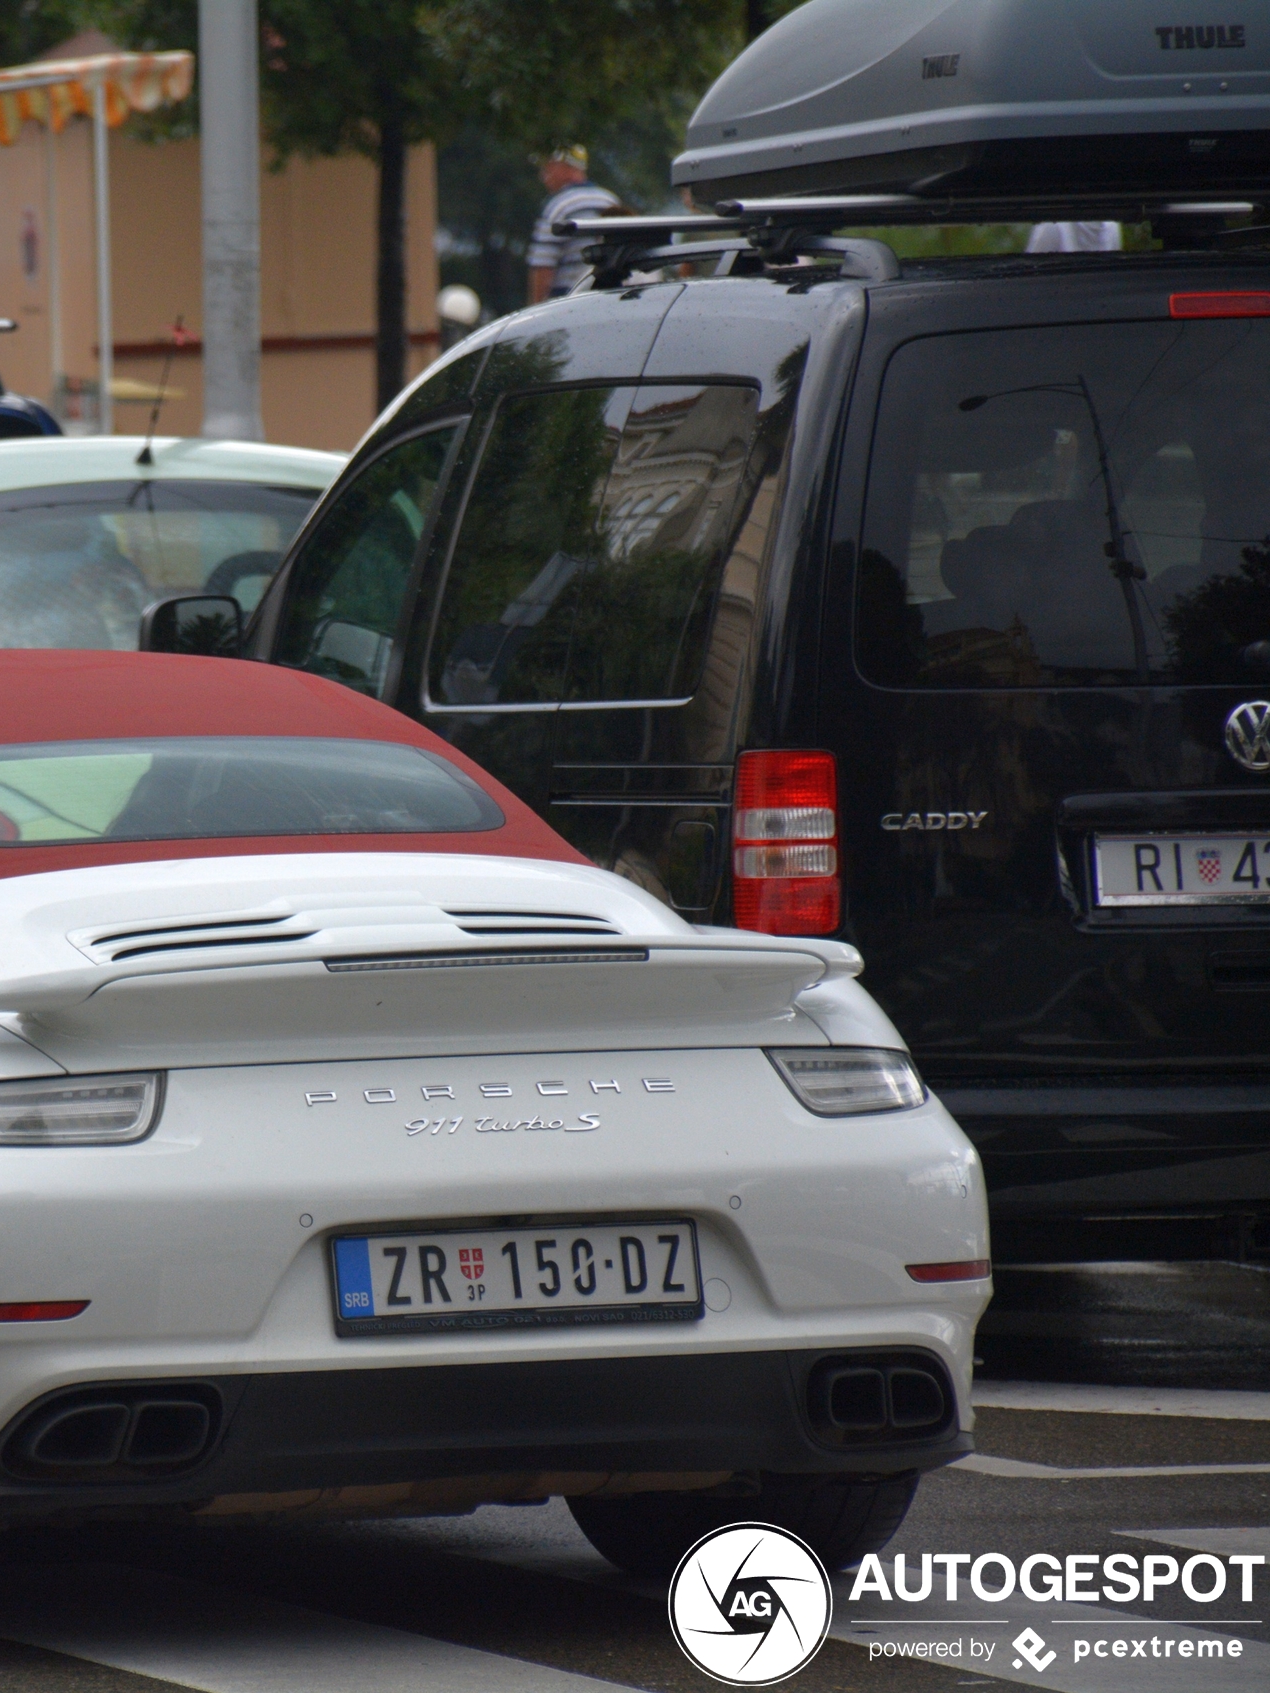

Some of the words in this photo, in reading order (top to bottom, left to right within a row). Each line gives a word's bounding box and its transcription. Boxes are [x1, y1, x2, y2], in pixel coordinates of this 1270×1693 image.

[1154, 25, 1246, 50] THULE
[922, 53, 960, 80] THULE
[881, 811, 988, 830] CADDY
[1134, 842, 1184, 892] RI
[304, 1077, 676, 1107] PORSCHE
[404, 1115, 465, 1137] 911
[382, 1244, 452, 1307] ZR
[344, 1292, 370, 1308] SRB
[574, 1313, 601, 1323] NOVI
[602, 1311, 626, 1322] SAD
